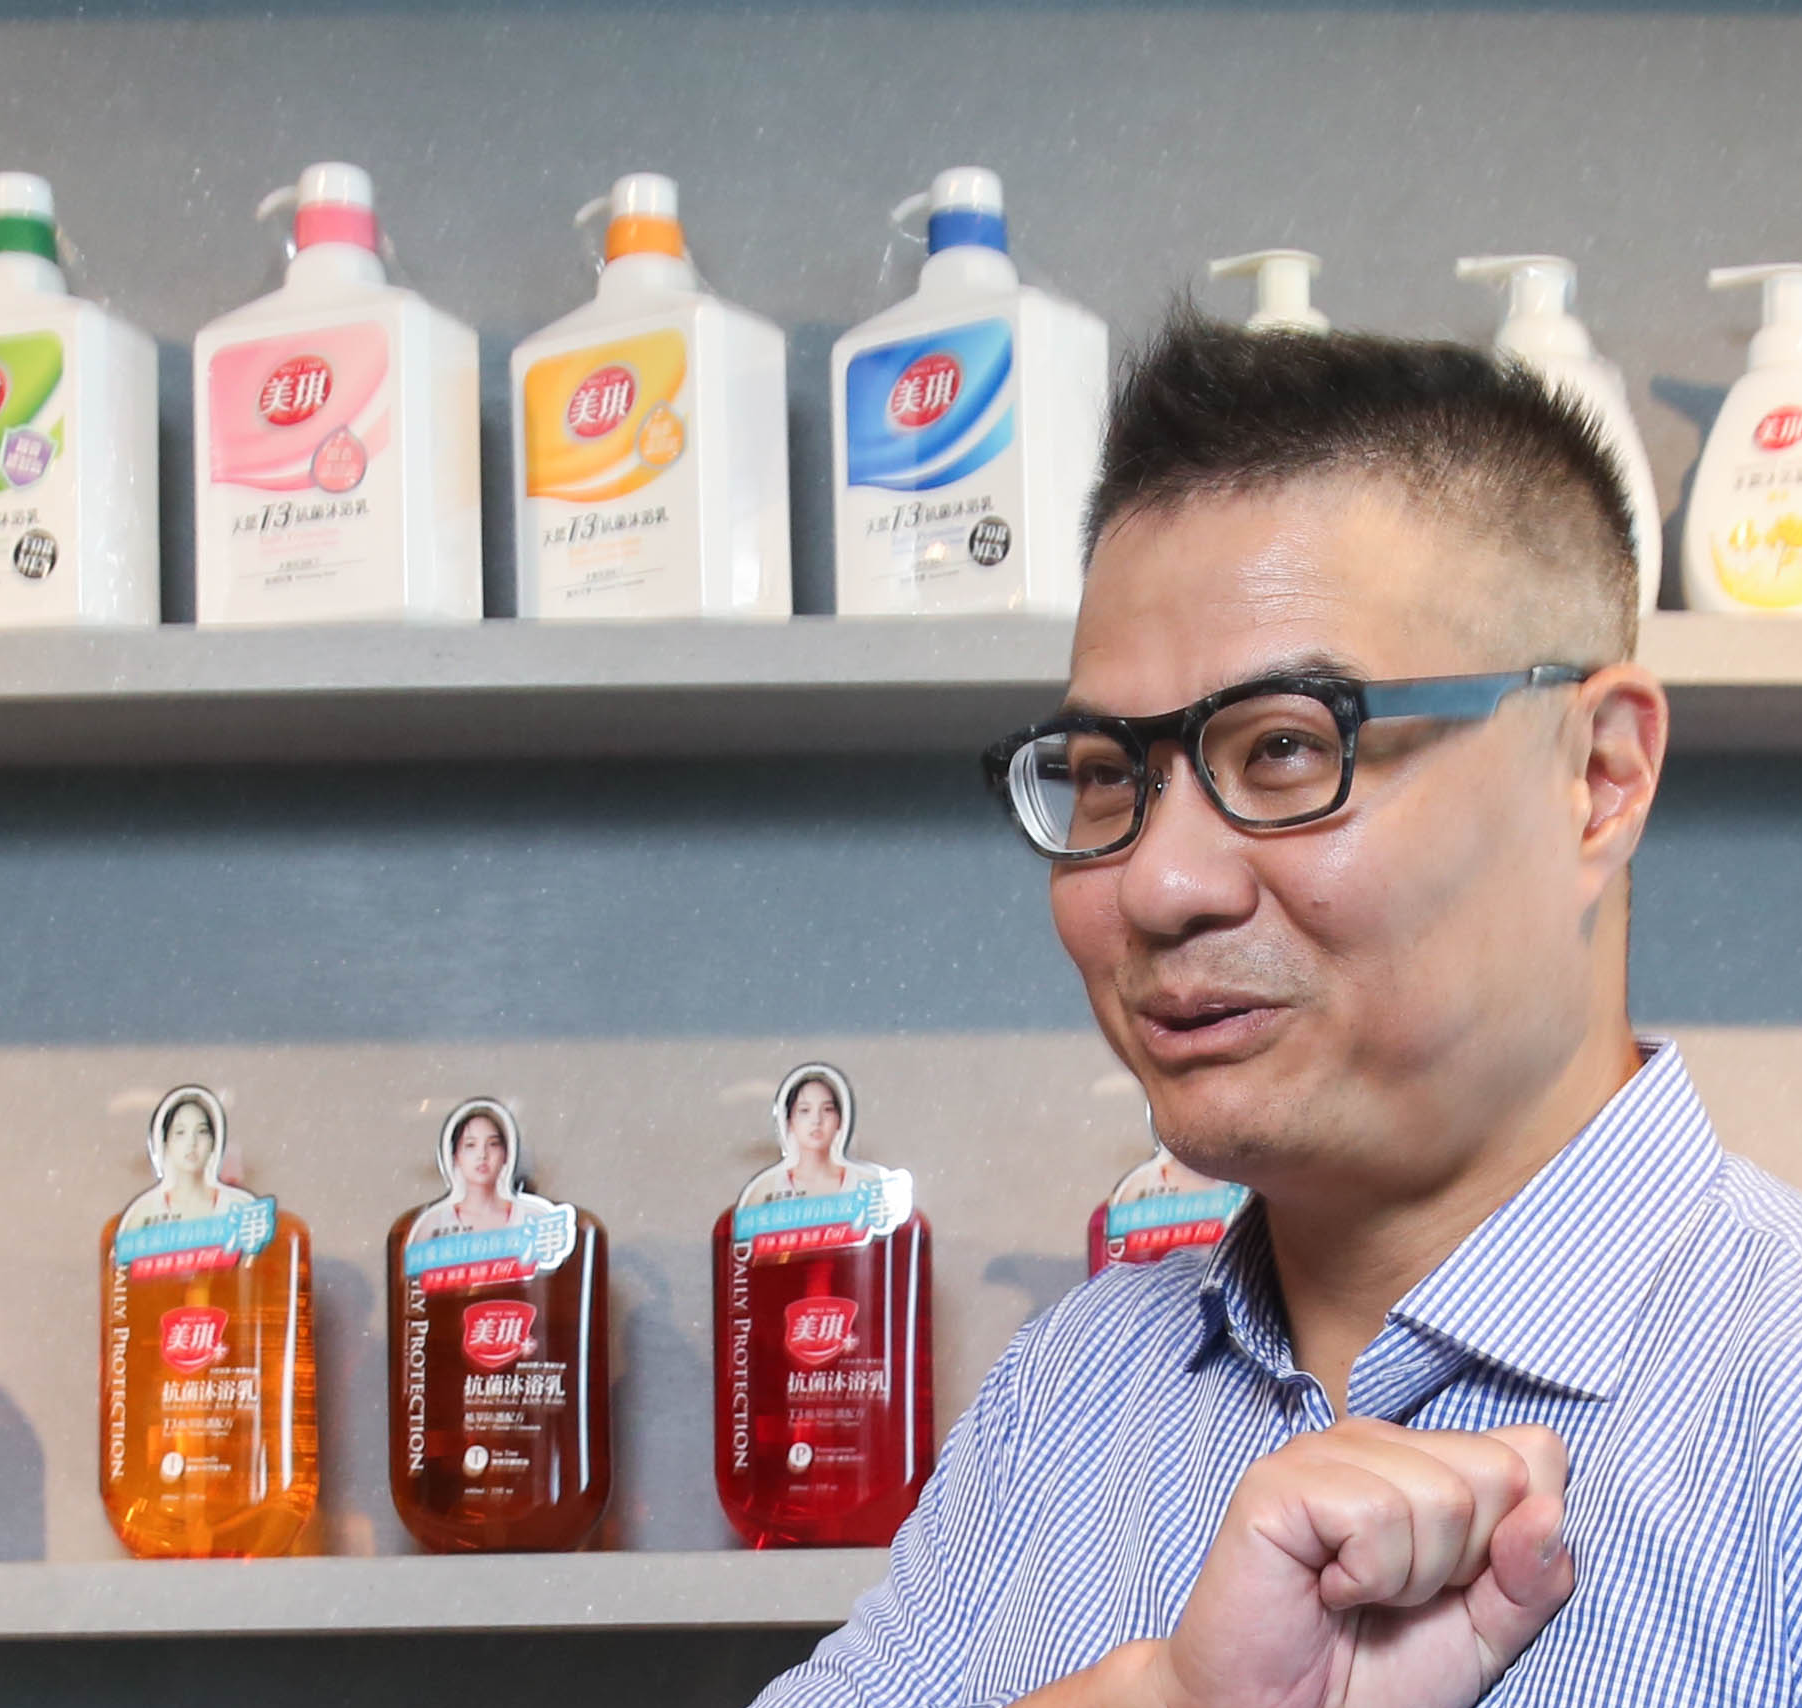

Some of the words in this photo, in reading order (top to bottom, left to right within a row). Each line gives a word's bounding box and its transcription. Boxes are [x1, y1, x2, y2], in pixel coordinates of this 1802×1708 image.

[260, 370, 327, 414] 美琪
[570, 381, 631, 427] 美琪
[891, 369, 955, 417] 美琪
[973, 543, 1005, 560] MEN
[978, 522, 1008, 540] FOR
[225, 1203, 268, 1253] 淨
[520, 1210, 567, 1266] 淨
[733, 1241, 751, 1311] DAILY
[166, 1323, 216, 1349] 美琪
[469, 1318, 524, 1344] 美琪
[791, 1314, 845, 1341] 美琪
[111, 1326, 130, 1478] PROTECTION
[162, 1380, 258, 1401] 抗菌沐浴乳
[409, 1320, 429, 1471] PROTECTION
[464, 1374, 566, 1396] 抗菌沐浴乳
[734, 1318, 751, 1468] PROTECTION
[788, 1370, 887, 1392] 抗菌沐浴乳
